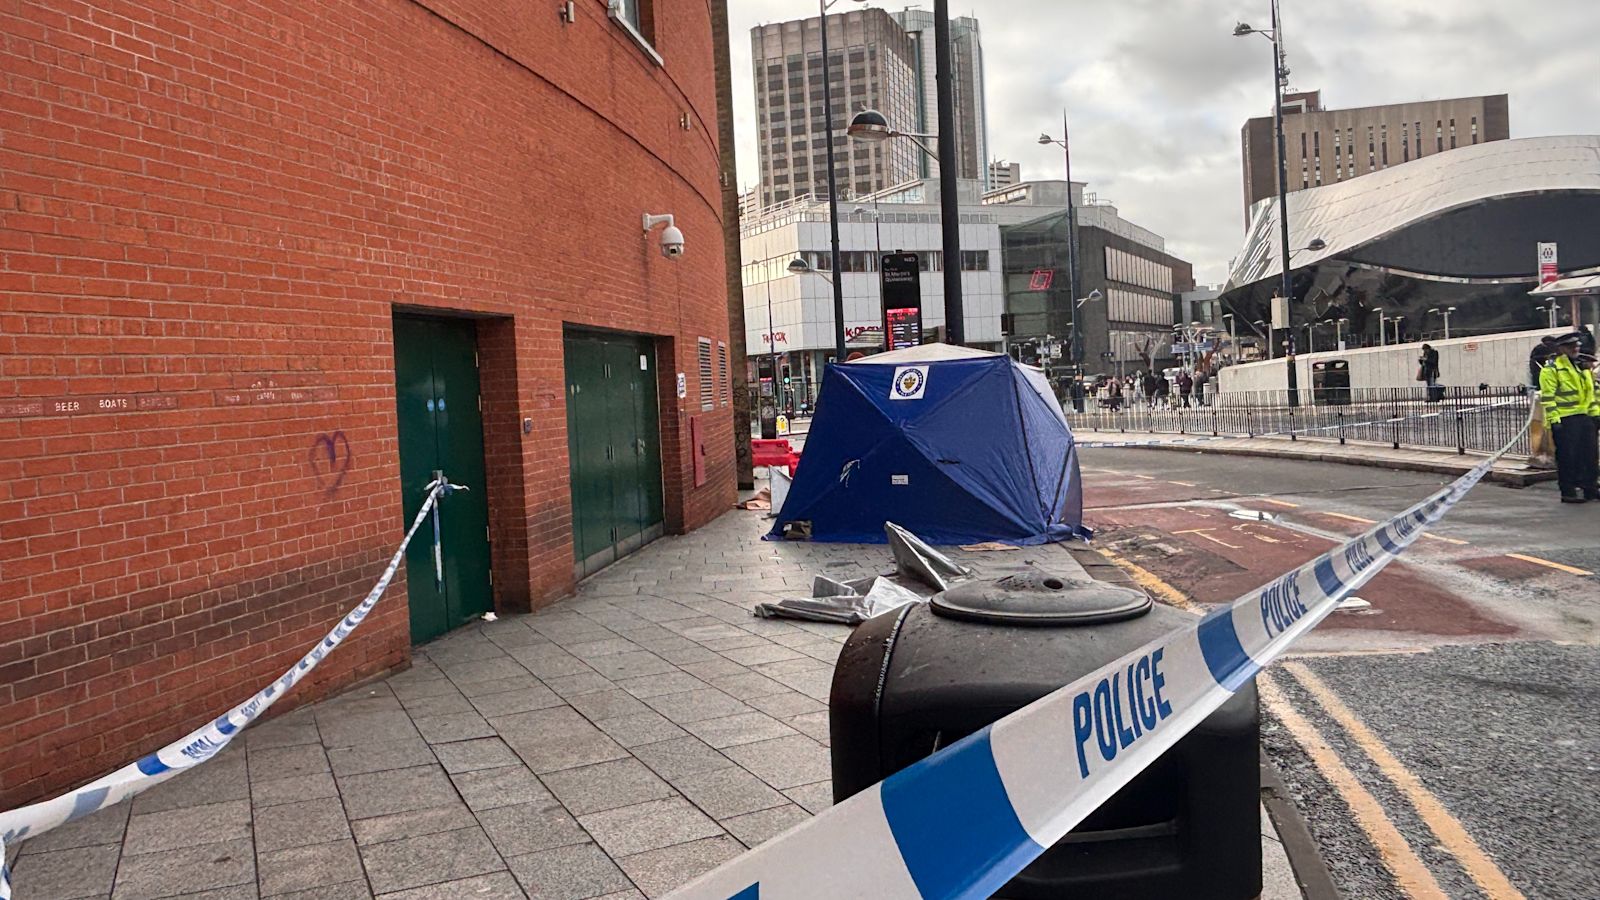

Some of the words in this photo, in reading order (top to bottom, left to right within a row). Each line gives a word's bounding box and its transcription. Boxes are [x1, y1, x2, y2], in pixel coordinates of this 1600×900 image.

[55, 401, 80, 412] BEER
[99, 398, 127, 409] BOATS
[1261, 569, 1308, 639] POLICE
[1073, 646, 1173, 779] POLICE
